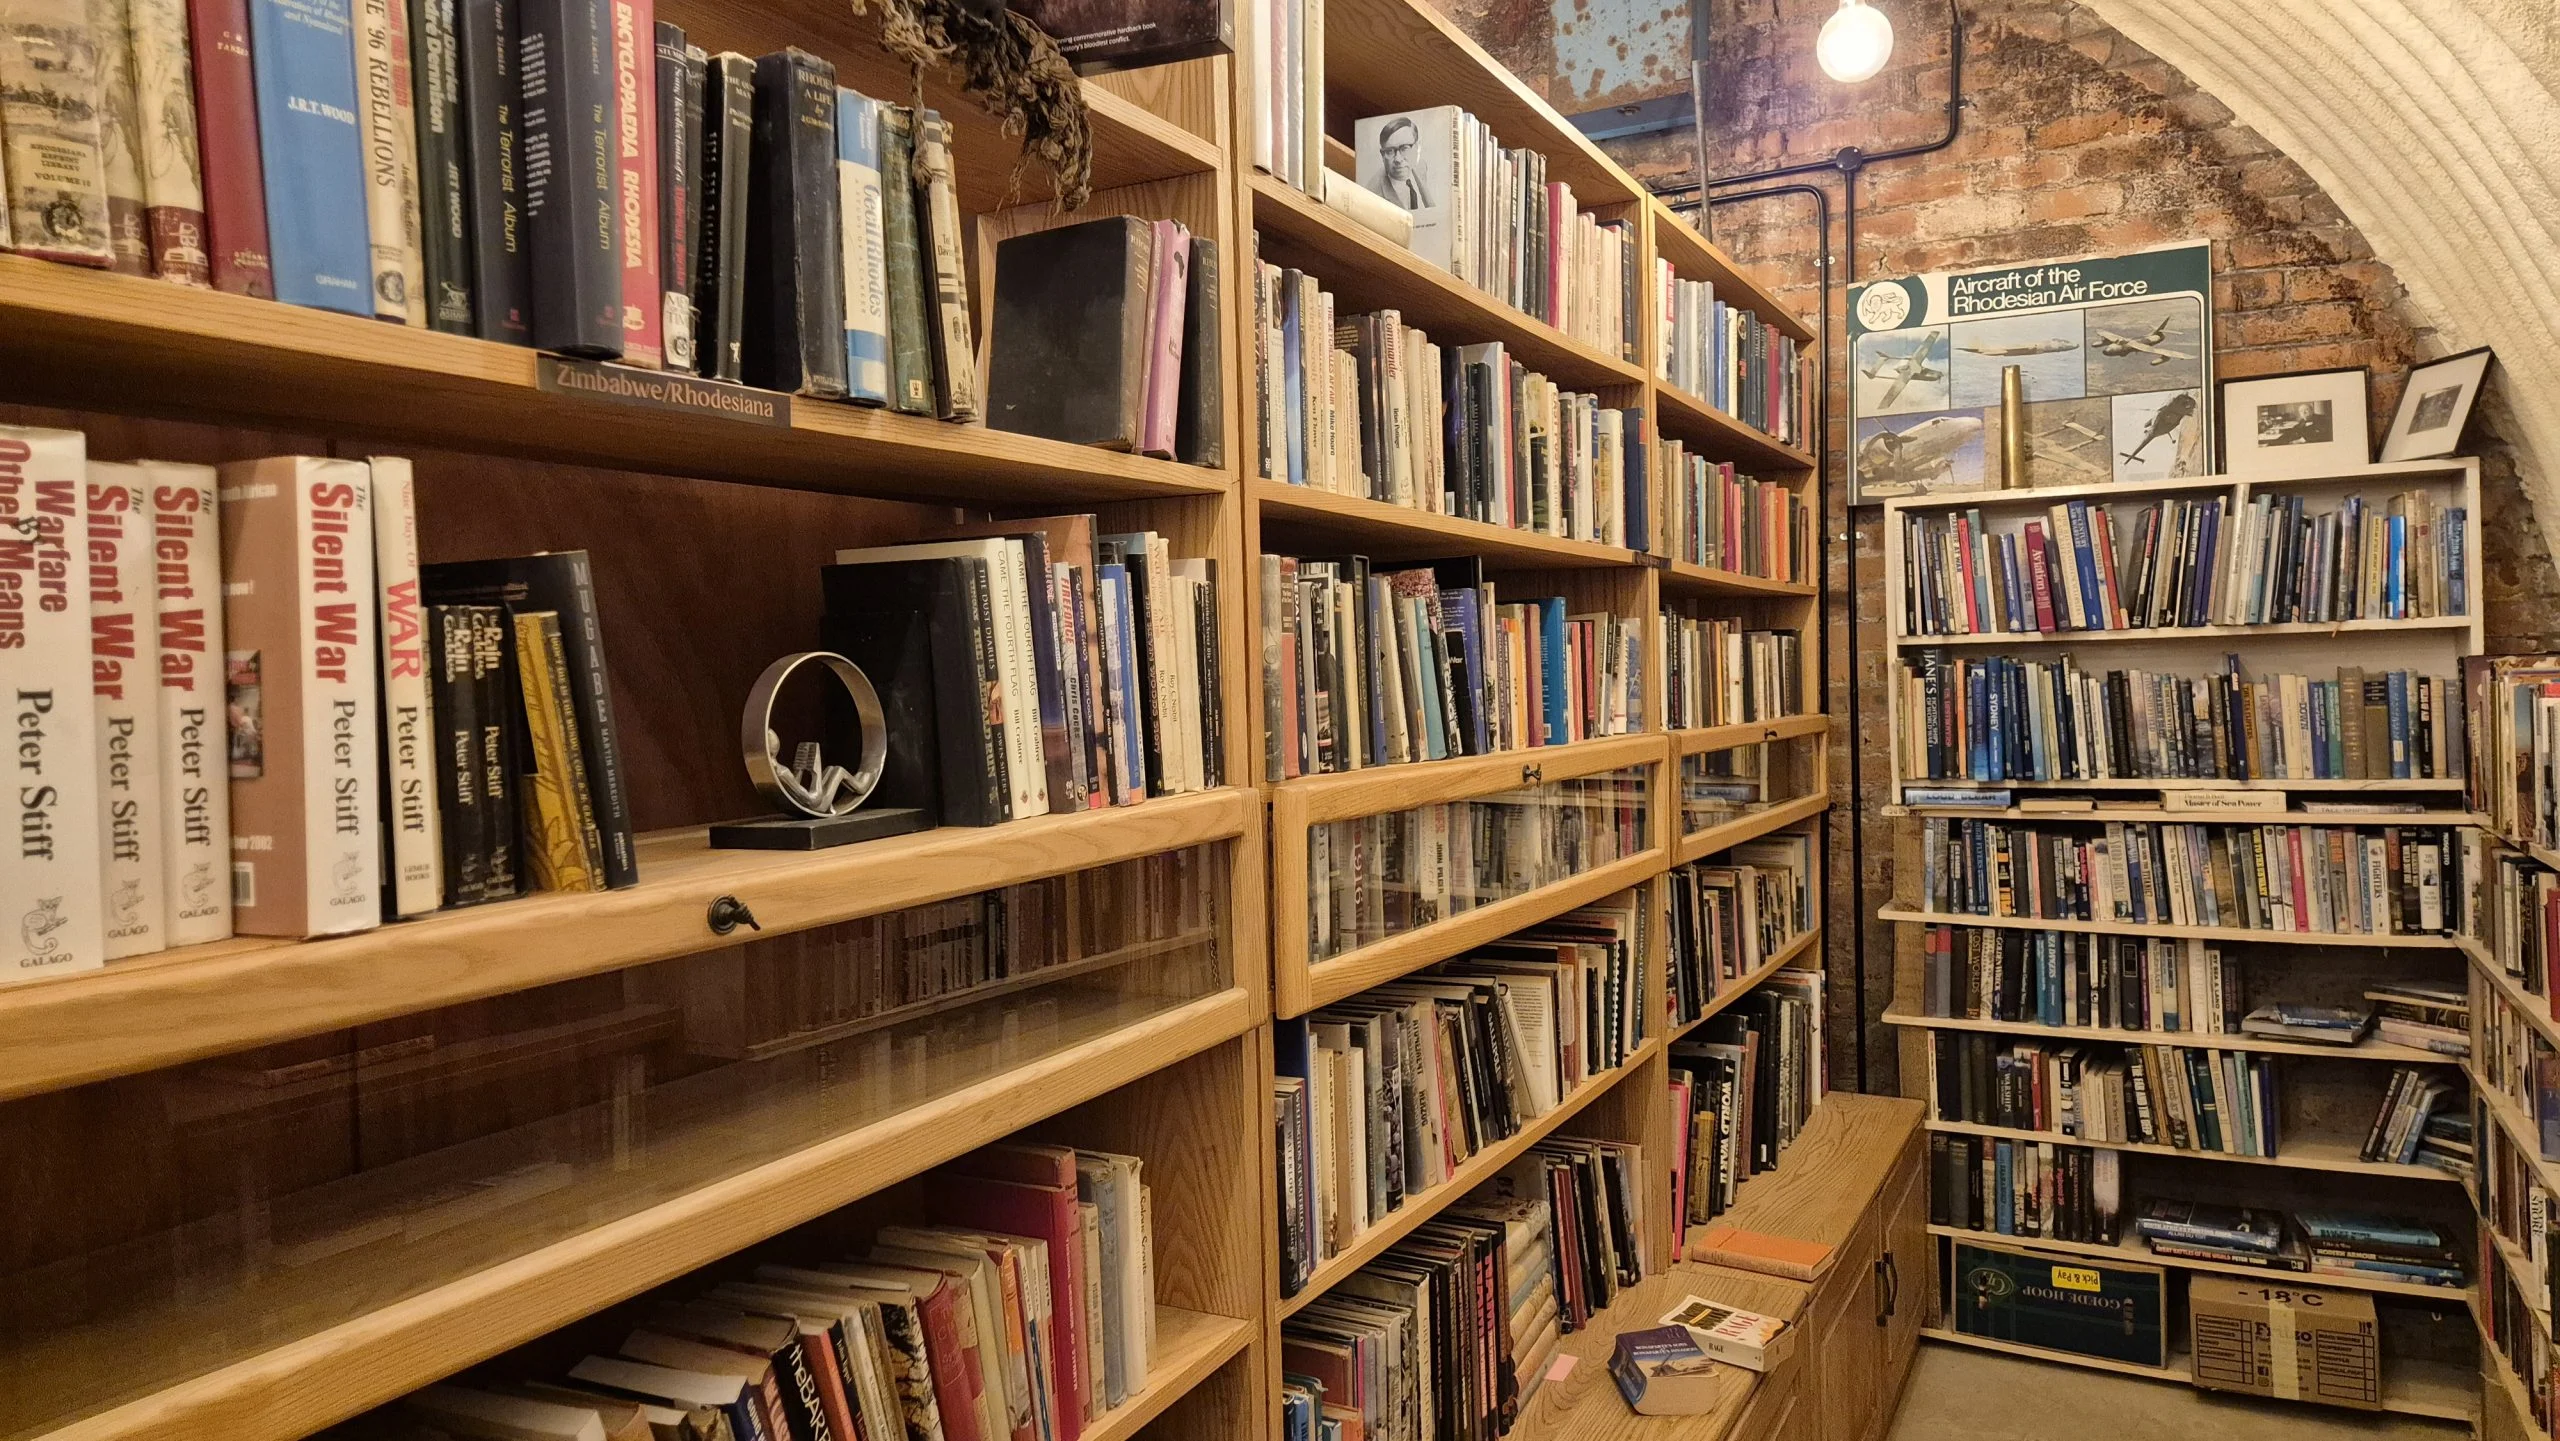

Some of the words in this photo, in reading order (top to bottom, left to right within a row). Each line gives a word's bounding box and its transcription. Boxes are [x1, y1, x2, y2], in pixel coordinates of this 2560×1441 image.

[1073, 27, 1117, 42] commemorative
[1117, 23, 1142, 36] hardback
[1142, 22, 1156, 32] book
[426, 36, 444, 133] Dennison
[616, 1, 641, 159] ENCYCLOPAEDIA
[288, 96, 322, 116] J.R.T.
[322, 104, 355, 126] WOOD
[369, 56, 395, 187] REBELLIONS
[498, 104, 509, 125] The
[593, 103, 602, 124] The
[502, 130, 515, 193] Terrorist
[596, 129, 608, 190] Terrorist
[450, 191, 462, 238] WOOD
[503, 201, 518, 253] Album
[598, 199, 611, 250] Album
[622, 169, 642, 269] RHODESIA
[864, 184, 881, 236] Cecil
[867, 237, 884, 318] Rhodes
[1953, 270, 2021, 297] Aircraft
[2025, 270, 2045, 288] of
[2049, 267, 2081, 286] the
[1953, 288, 2056, 314] Rhodesian
[2058, 285, 2088, 303] Air
[2089, 278, 2148, 301] Force
[1385, 314, 1400, 380] Commander
[557, 363, 775, 418] Zimbabwe/Rhodesiana
[131, 487, 144, 514] The
[201, 488, 213, 515] The
[356, 484, 367, 512] The
[35, 480, 76, 613] Warfare
[86, 484, 130, 604] Silent
[154, 485, 200, 600] Silent
[310, 481, 354, 594] Silent
[998, 550, 1007, 583] CAME
[1016, 551, 1025, 585] CAME
[2032, 548, 2047, 590] Aviation
[0, 540, 35, 650] Means
[981, 594, 991, 622] DUST
[1002, 588, 1010, 611] THE
[1021, 588, 1029, 612] THE
[159, 608, 206, 692] War
[314, 603, 358, 684] War
[386, 578, 422, 681] WAR
[453, 629, 472, 673] Rain
[484, 627, 503, 670] Rain
[573, 562, 608, 723] MUGABE
[985, 627, 996, 670] DIARIES
[1005, 616, 1015, 663] FOURTH
[1024, 616, 1034, 663] FOURTH
[91, 613, 135, 701] War
[1061, 577, 1075, 646] FIREFORCE
[1072, 708, 1080, 738] Cocks
[1924, 654, 1938, 695] JANE'S
[1010, 667, 1018, 697] FLAG
[1028, 667, 1037, 697] FLAG
[16, 688, 53, 776] Peter
[333, 699, 356, 768] Peter
[1989, 693, 2000, 732] SYDNEY
[108, 716, 134, 791] Peter
[180, 707, 204, 778] Peter
[396, 706, 418, 771] Peter
[455, 730, 470, 767] Peter
[484, 725, 501, 764] Peter
[602, 728, 613, 767] MARTIN
[400, 778, 425, 834] Stiff
[458, 769, 474, 806] Stiff
[487, 766, 503, 799] Stiff
[607, 768, 622, 819] MEREDITH
[2184, 798, 2212, 808] Master
[2221, 799, 2236, 808] Sea
[19, 785, 58, 862] Stiff
[183, 787, 211, 847] Stiff
[335, 777, 360, 836] Stiff
[112, 800, 140, 864] Stiff
[179, 906, 219, 920] GALAGO
[329, 895, 366, 907] GALAGO
[107, 924, 149, 939] GALAGO
[1973, 930, 1981, 953] LOST
[20, 952, 73, 969] GALAGO
[1972, 955, 1981, 993] WORLDS
[1488, 1012, 1501, 1083] GALLIPOLI
[1294, 1092, 1303, 1161] WELLINGTON
[1721, 1081, 1732, 1135] WORLD
[1286, 1131, 1294, 1194] WATERLOO
[1720, 1138, 1730, 1171] WAR
[1296, 1176, 1306, 1233] WATERLOO
[2057, 1269, 2073, 1284] Pay
[2083, 1271, 2099, 1285] Pick
[2258, 1288, 2324, 1307] 18°C
[1709, 1342, 1725, 1354] RAGE
[1716, 1313, 1760, 1338] RAGE
